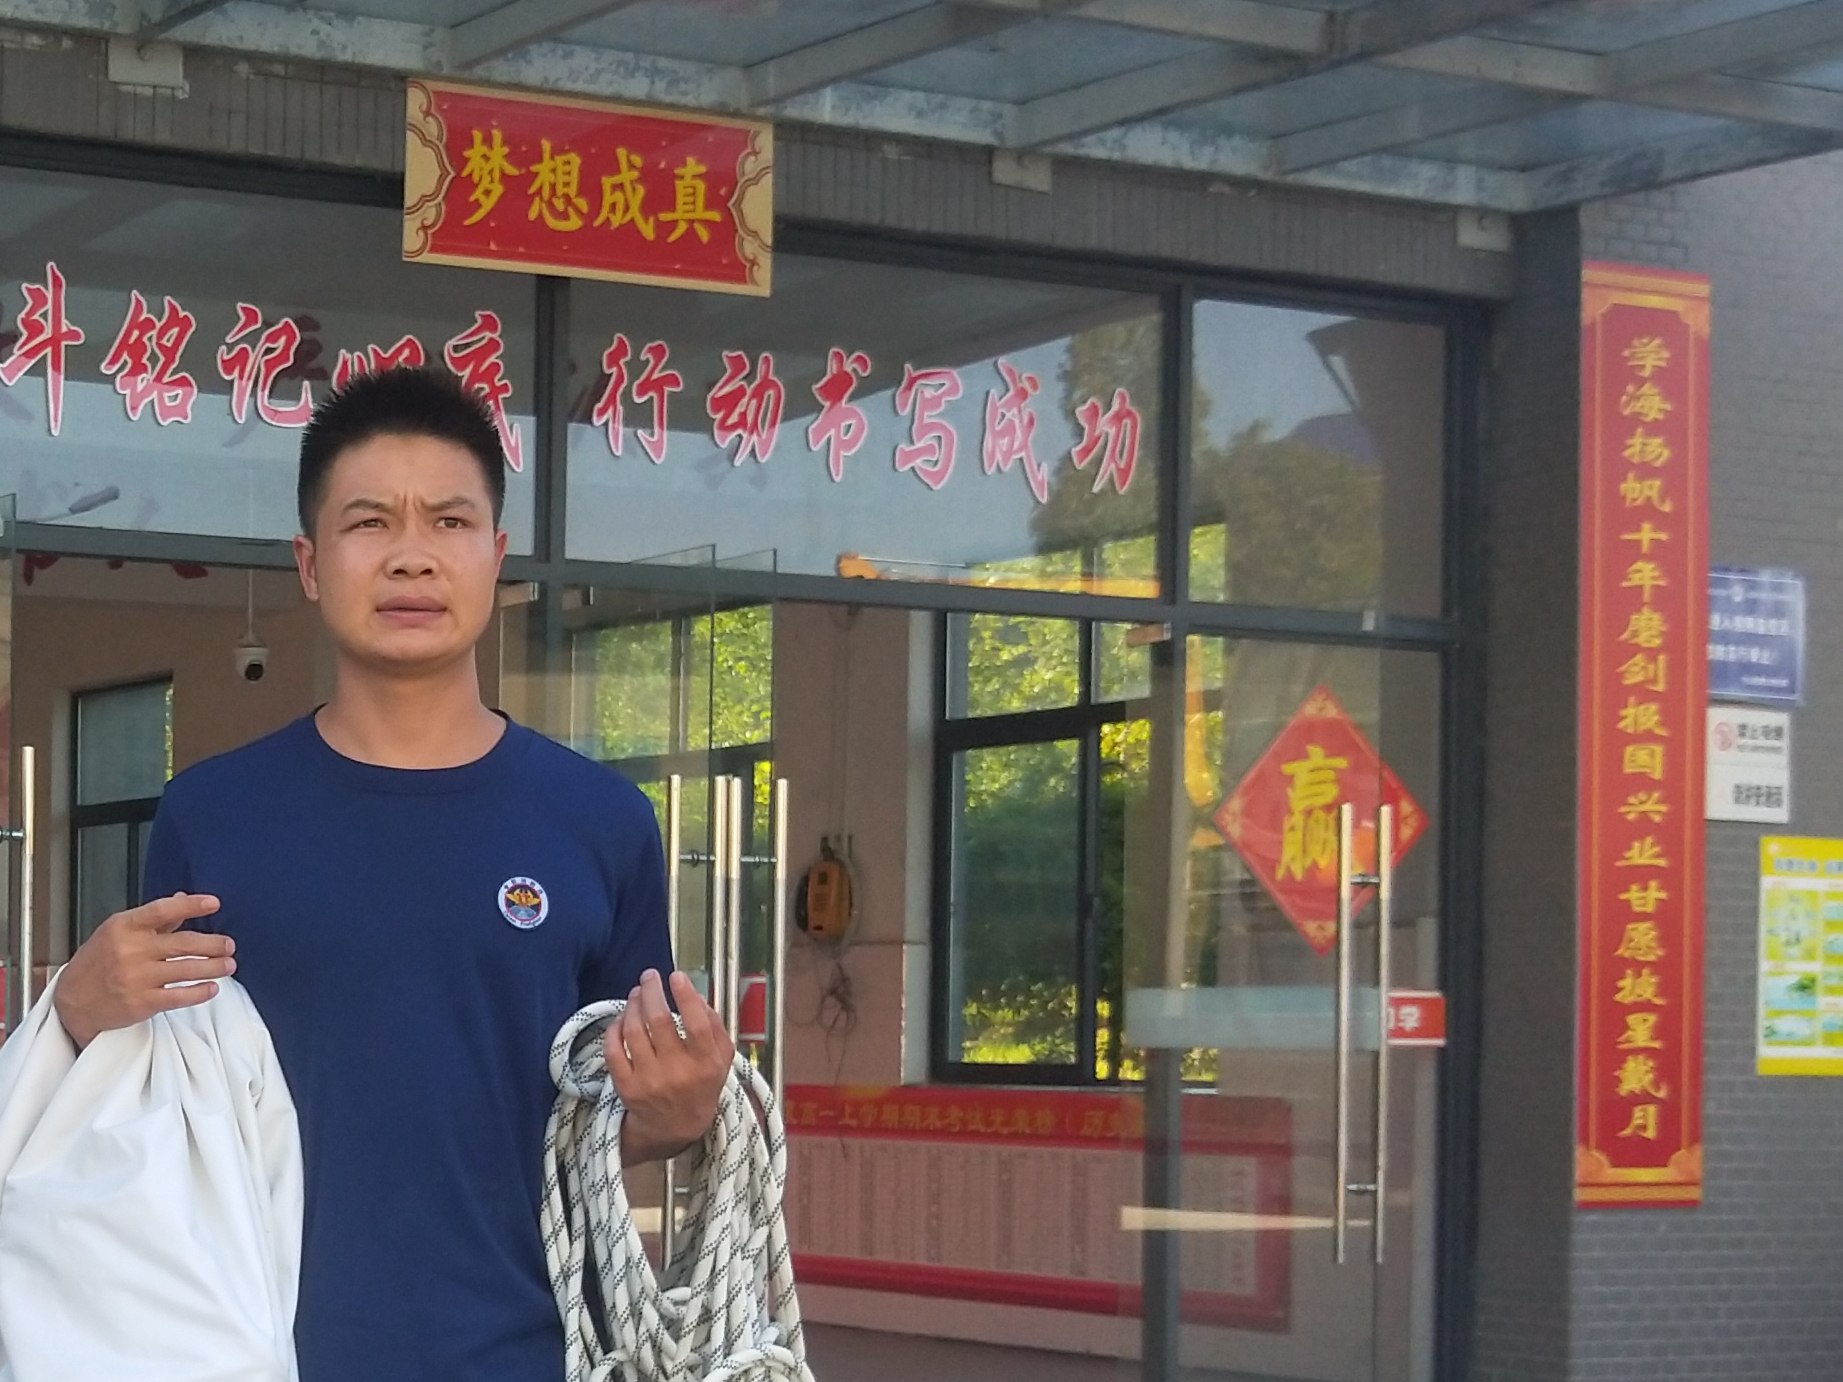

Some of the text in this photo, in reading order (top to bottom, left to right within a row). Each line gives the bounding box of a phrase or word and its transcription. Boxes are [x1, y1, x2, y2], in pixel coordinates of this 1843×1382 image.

[460, 129, 723, 244] 梦想成真
[592, 331, 1142, 504] 行动书写成功
[1614, 337, 1673, 1139] 学海扬帆十年磨剑报国兴业甘愿披星戴月
